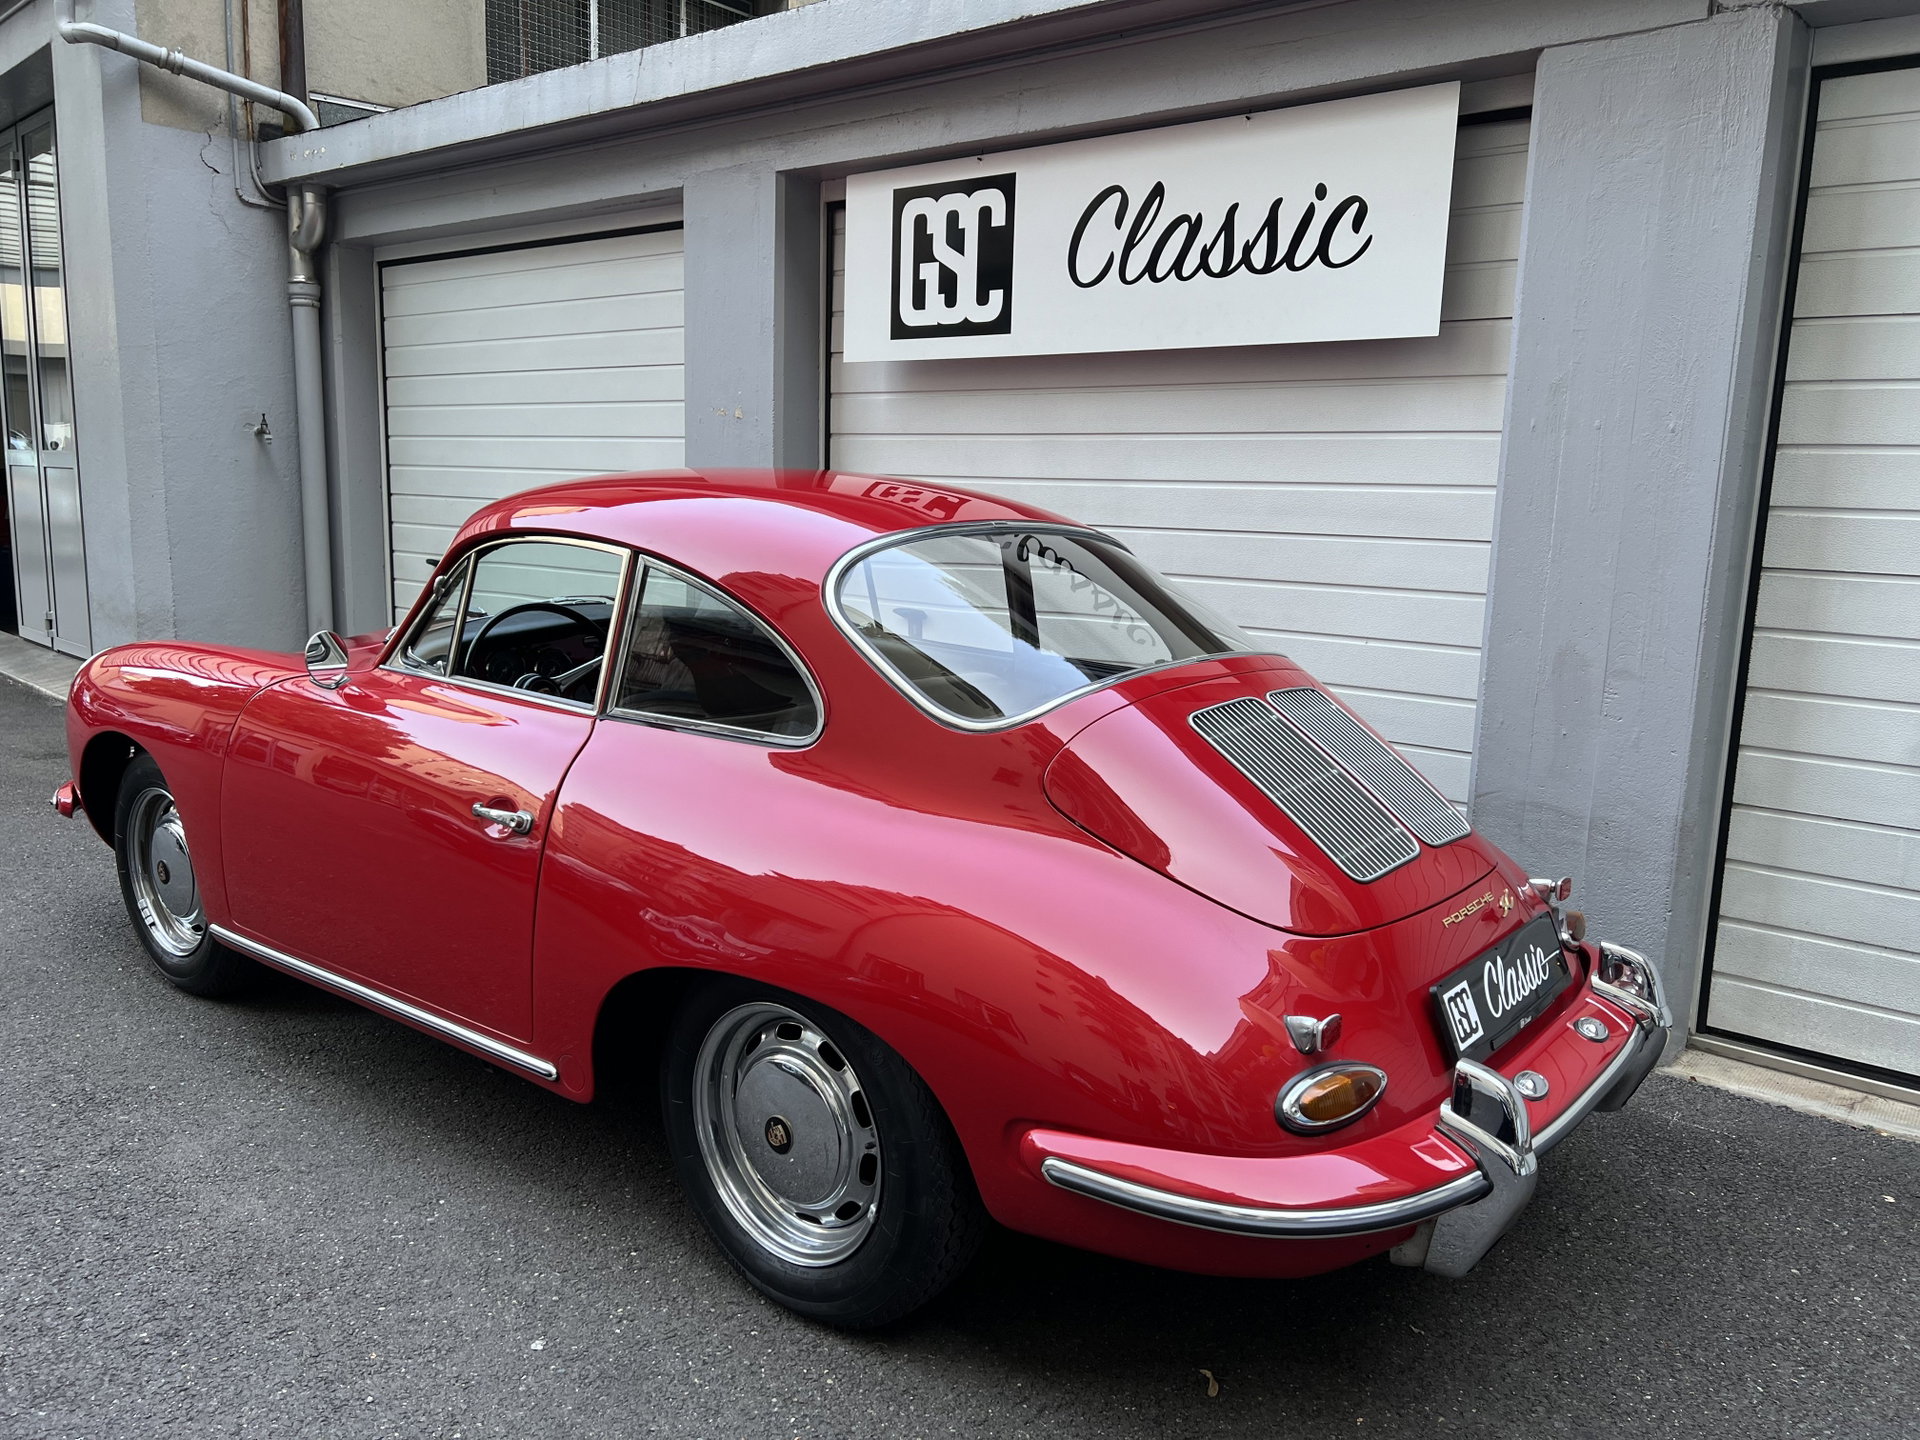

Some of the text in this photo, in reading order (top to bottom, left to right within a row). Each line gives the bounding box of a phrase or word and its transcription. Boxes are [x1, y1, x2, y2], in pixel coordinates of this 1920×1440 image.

[898, 180, 1373, 328] GSC Classic
[1442, 891, 1495, 929] PORSCHE
[1446, 943, 1551, 1045] GSC Classic
